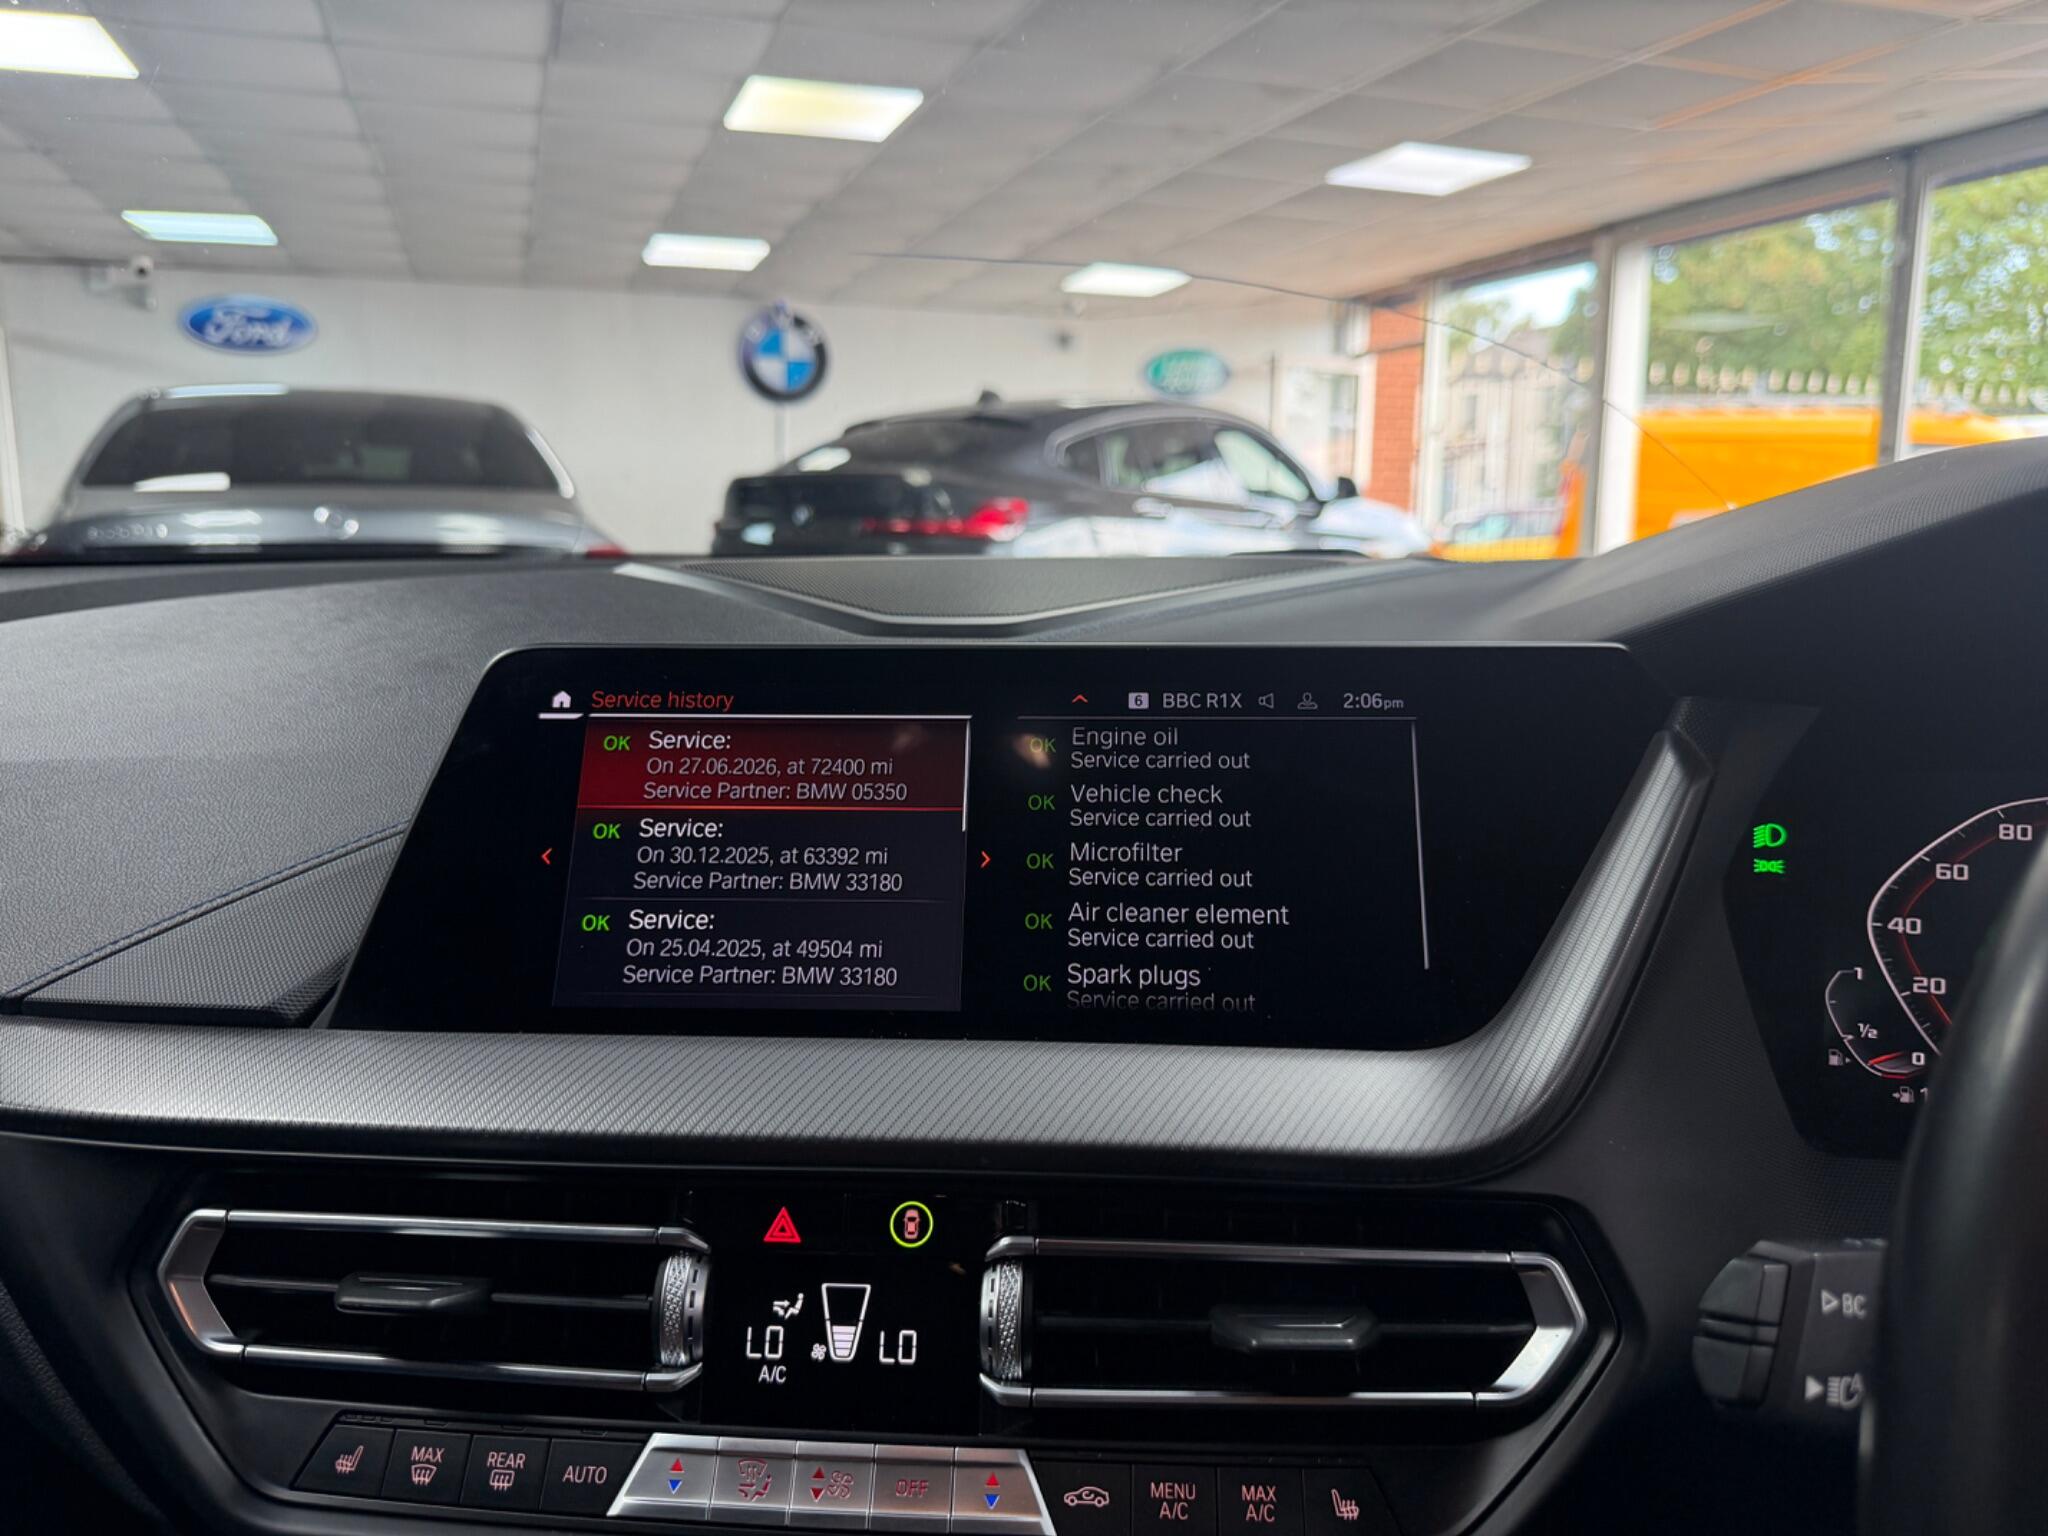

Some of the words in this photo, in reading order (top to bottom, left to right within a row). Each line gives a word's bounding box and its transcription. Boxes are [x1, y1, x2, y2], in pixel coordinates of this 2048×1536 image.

[203, 306, 296, 347] Ford
[591, 690, 662, 708] Service
[668, 691, 734, 712] history
[1133, 694, 1145, 709] 6
[1162, 692, 1201, 709] BBC
[1206, 692, 1242, 708] R1X
[603, 735, 630, 751] OK
[648, 730, 731, 750] Service:
[1029, 736, 1056, 753] OK
[1072, 727, 1147, 749] Engine
[1153, 727, 1178, 746] oil
[646, 756, 674, 775] On
[678, 757, 781, 777] 27.06.2026,
[786, 759, 805, 775] at
[811, 758, 865, 776] 72400
[871, 758, 893, 775] mi
[1071, 751, 1140, 769] Service
[1145, 751, 1212, 769] carried
[1218, 752, 1250, 769] out
[643, 781, 712, 799] Service
[717, 781, 791, 799] Partner:
[796, 782, 847, 800] BMW
[851, 783, 907, 801] 05350
[1070, 783, 1151, 804] Vehicle
[1157, 784, 1223, 804] check
[1027, 794, 1056, 811] OK
[639, 817, 724, 838] Service:
[1070, 808, 1140, 827] Service
[1145, 809, 1212, 827] carried
[1218, 810, 1251, 828] out
[592, 823, 620, 840] OK
[1998, 823, 2033, 841] 80
[637, 845, 665, 864] On
[669, 845, 774, 866] 30.12.2025,
[779, 847, 799, 864] at
[803, 846, 860, 866] 63392
[865, 847, 888, 865] mi
[1026, 852, 1054, 870] OK
[1070, 841, 1183, 863] Microfilter
[633, 871, 704, 890] Service
[709, 871, 784, 890] Partner:
[789, 872, 841, 890] BMW
[845, 873, 903, 892] 33180
[1069, 867, 1140, 886] Service
[1145, 868, 1213, 887] carried
[1219, 870, 1253, 888] out
[1935, 863, 1969, 881] 60
[581, 914, 610, 932] OK
[628, 908, 715, 930] Service:
[1024, 912, 1053, 930] OK
[1067, 901, 1100, 922] Air
[1106, 902, 1190, 924] cleaner
[1195, 903, 1289, 925] element
[1886, 916, 1922, 935] 40
[1067, 927, 1140, 947] Service
[1145, 929, 1214, 949] carried
[1220, 931, 1254, 950] out
[626, 938, 655, 957] On
[659, 938, 766, 960] 25.04.2025,
[772, 940, 791, 958] at
[796, 939, 853, 959] 49504
[859, 940, 883, 958] mi
[623, 964, 694, 984] Service
[699, 965, 776, 984] Partner:
[782, 966, 835, 985] BMW
[839, 966, 898, 986] 33180
[1023, 974, 1052, 992] OK
[1067, 962, 1132, 988] Spark
[1139, 964, 1201, 990] plugs
[1853, 966, 1863, 980] 1
[1912, 976, 1947, 995] 20
[1067, 989, 1139, 1009] Service
[1145, 991, 1215, 1011] carried
[1222, 993, 1256, 1012] out
[1911, 1052, 1925, 1066] 0
[1842, 1293, 1866, 1318] BC
[746, 1326, 784, 1359] LO
[879, 1330, 917, 1364] LO
[758, 1364, 787, 1384] A/C
[411, 1446, 444, 1464] MAX
[487, 1451, 526, 1470] REAR
[562, 1465, 608, 1485] AUTO
[895, 1478, 929, 1497] OFF
[1150, 1482, 1196, 1500] MENU
[1241, 1485, 1277, 1502] MAX
[1159, 1502, 1189, 1520] A/C
[1246, 1504, 1275, 1522] A/C
